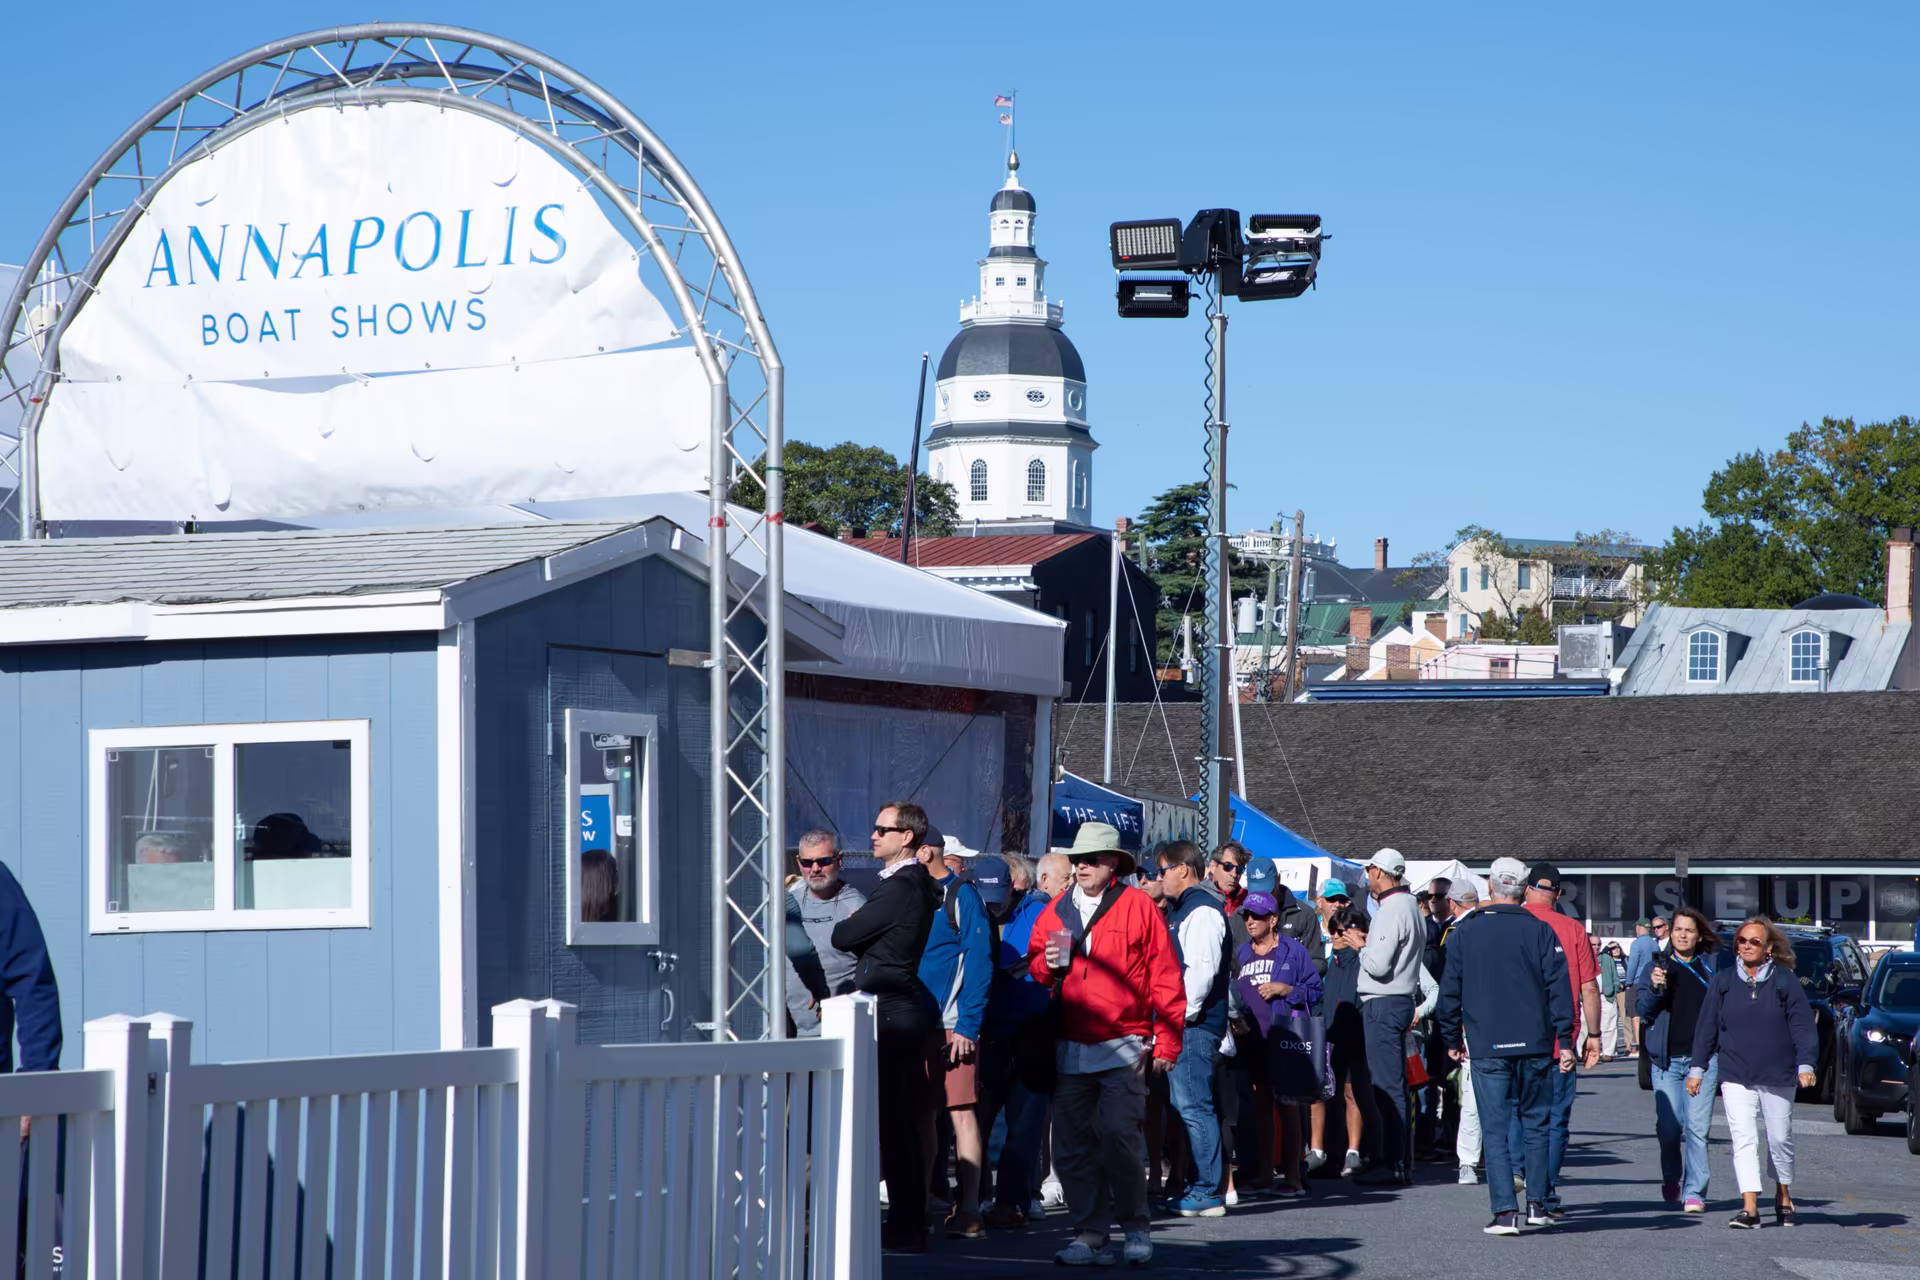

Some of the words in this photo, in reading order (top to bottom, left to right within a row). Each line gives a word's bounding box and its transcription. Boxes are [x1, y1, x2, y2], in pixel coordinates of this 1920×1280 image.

[143, 203, 567, 288] ANNAPOLIS
[202, 308, 301, 346] BOAT
[331, 298, 486, 338] SHOWS
[1774, 880, 1862, 919] UP
[1280, 1040, 1312, 1051] axos
